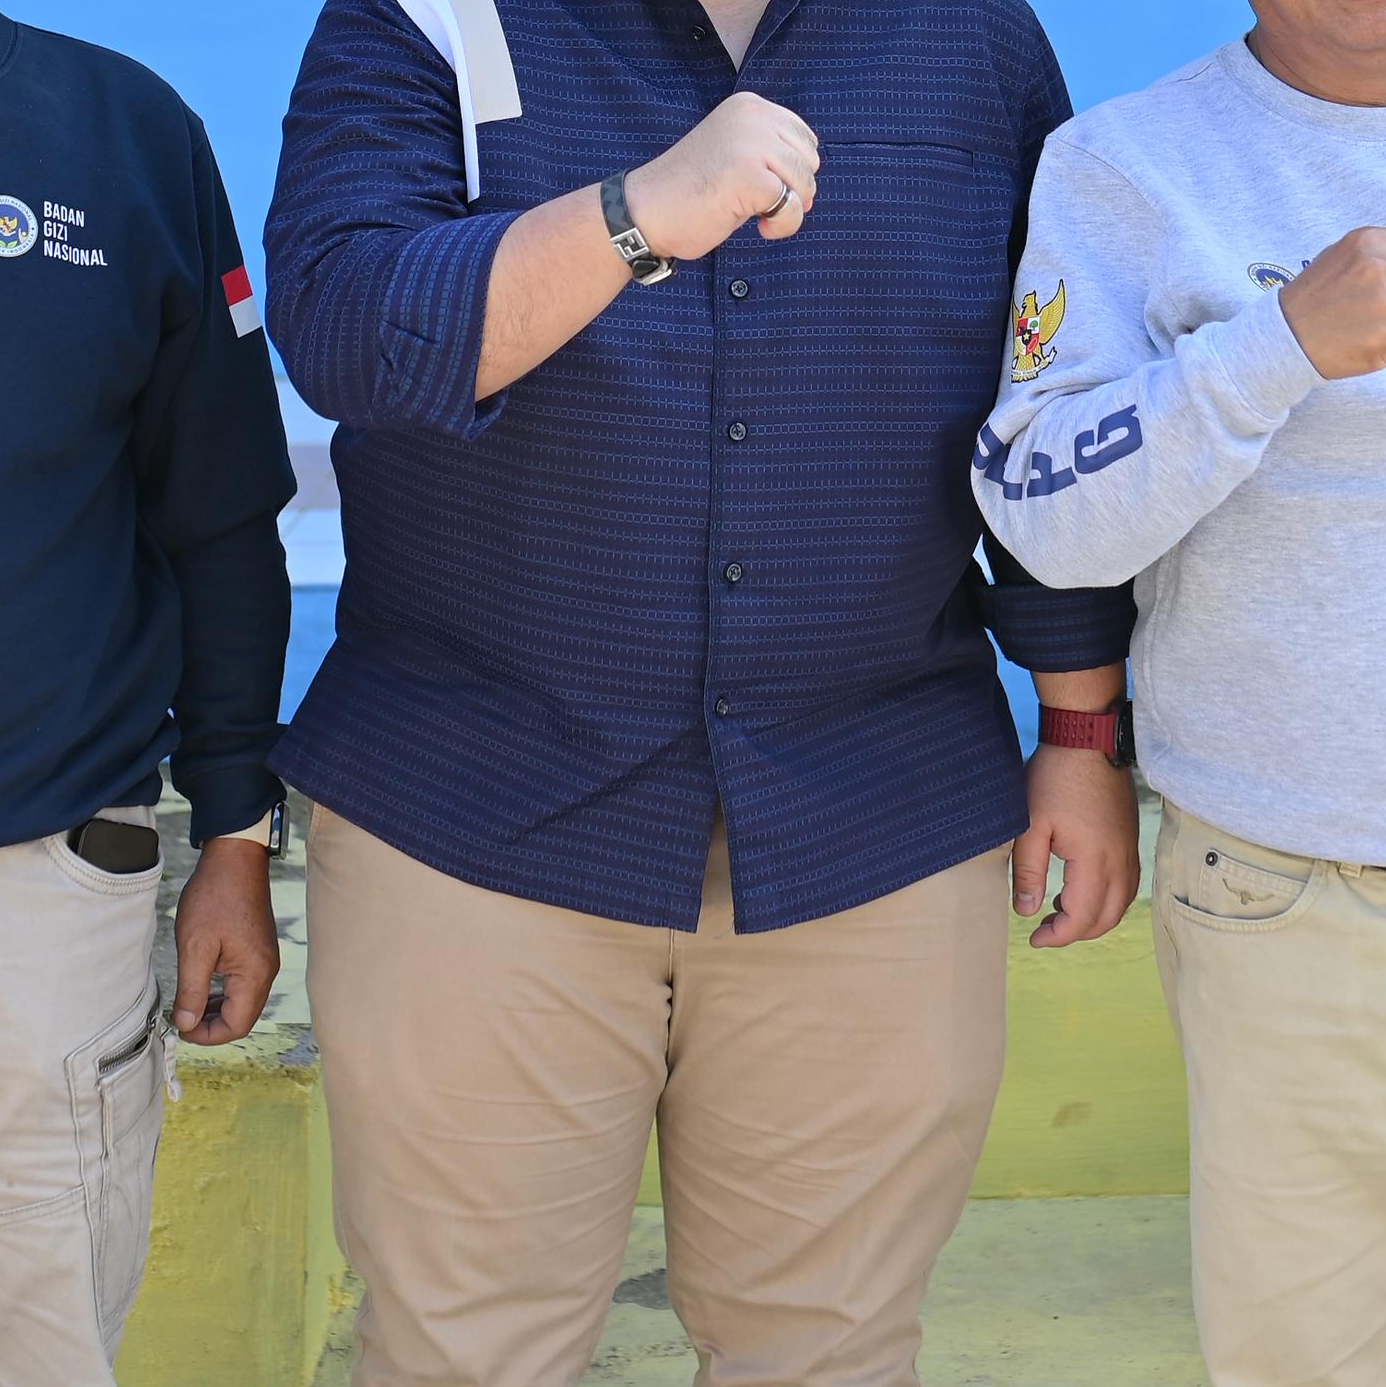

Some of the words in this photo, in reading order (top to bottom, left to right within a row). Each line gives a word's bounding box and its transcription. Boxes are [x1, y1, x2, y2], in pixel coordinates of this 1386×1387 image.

[43, 201, 85, 227] BADAN
[43, 220, 68, 242] GIZI
[43, 239, 108, 267] NASIONAL
